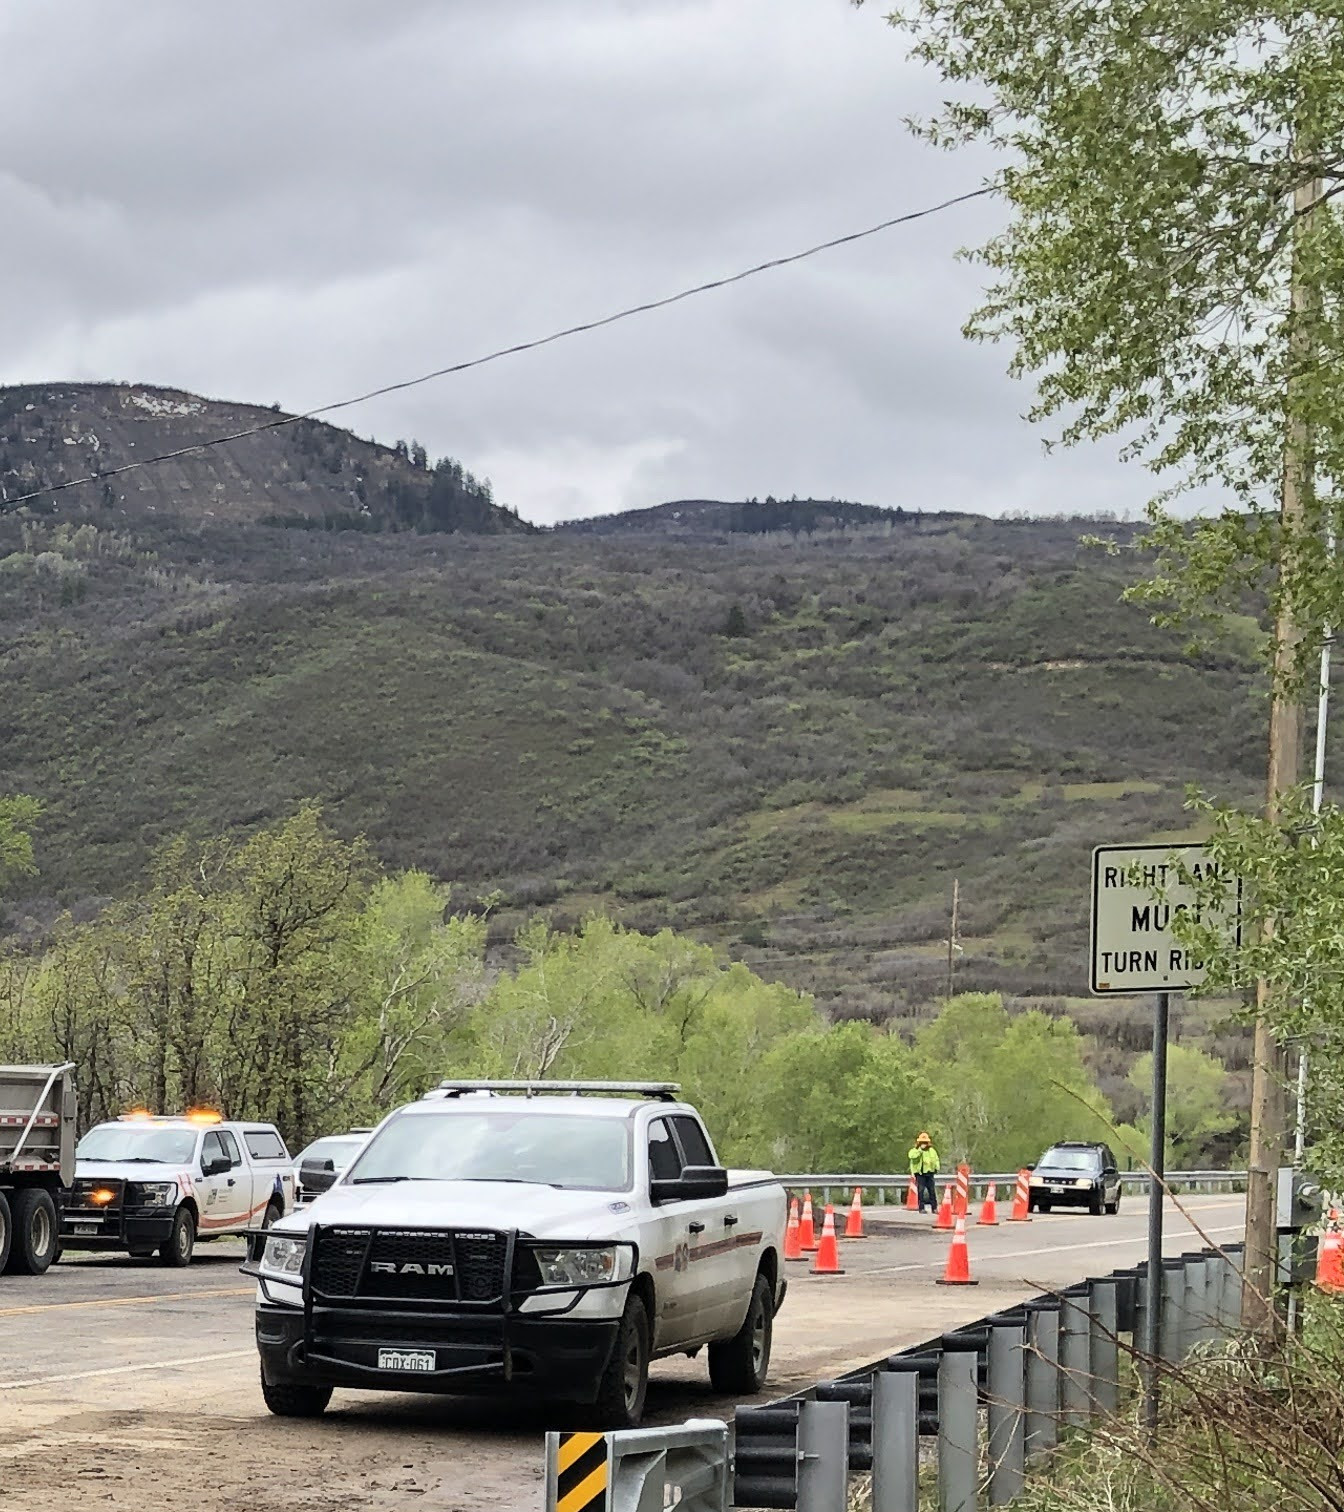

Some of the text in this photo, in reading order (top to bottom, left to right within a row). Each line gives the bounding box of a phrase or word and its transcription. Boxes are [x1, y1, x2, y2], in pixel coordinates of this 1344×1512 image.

[1105, 864, 1169, 888] RIHT
[1101, 950, 1157, 973] TURN
[370, 1261, 454, 1275] RAM
